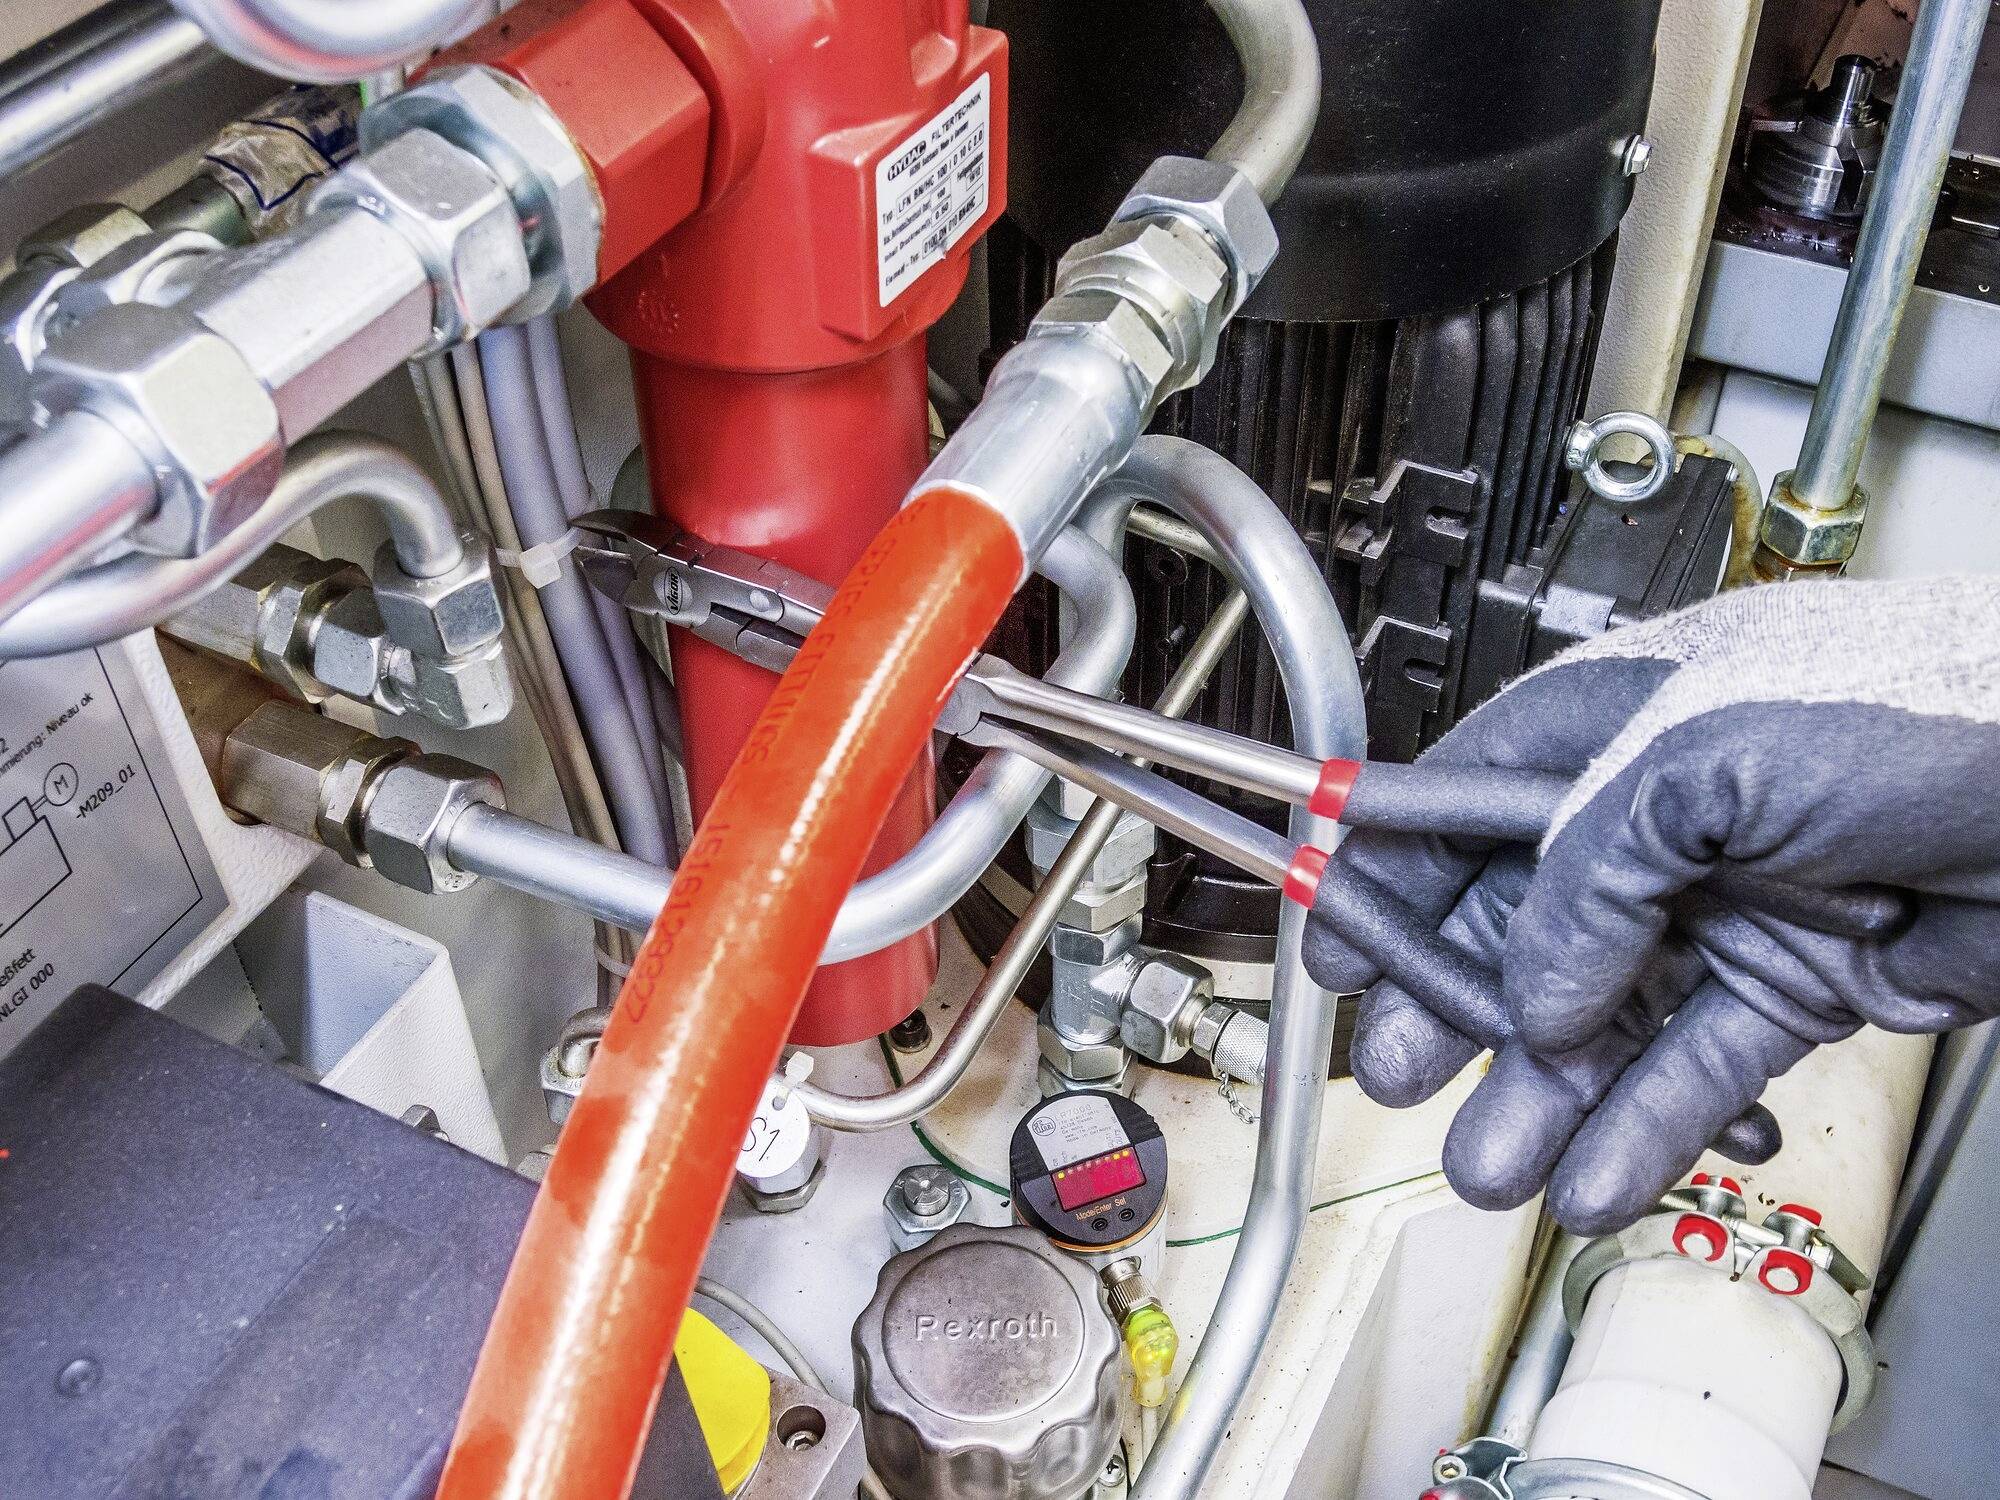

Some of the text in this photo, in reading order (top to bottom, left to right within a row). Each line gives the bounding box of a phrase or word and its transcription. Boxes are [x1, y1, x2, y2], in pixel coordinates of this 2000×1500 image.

[53, 774, 70, 796] M
[76, 763, 136, 819] -M209_01
[29, 963, 54, 991] 000
[741, 1116, 781, 1162] S1
[914, 1311, 1059, 1342] Rexroth
